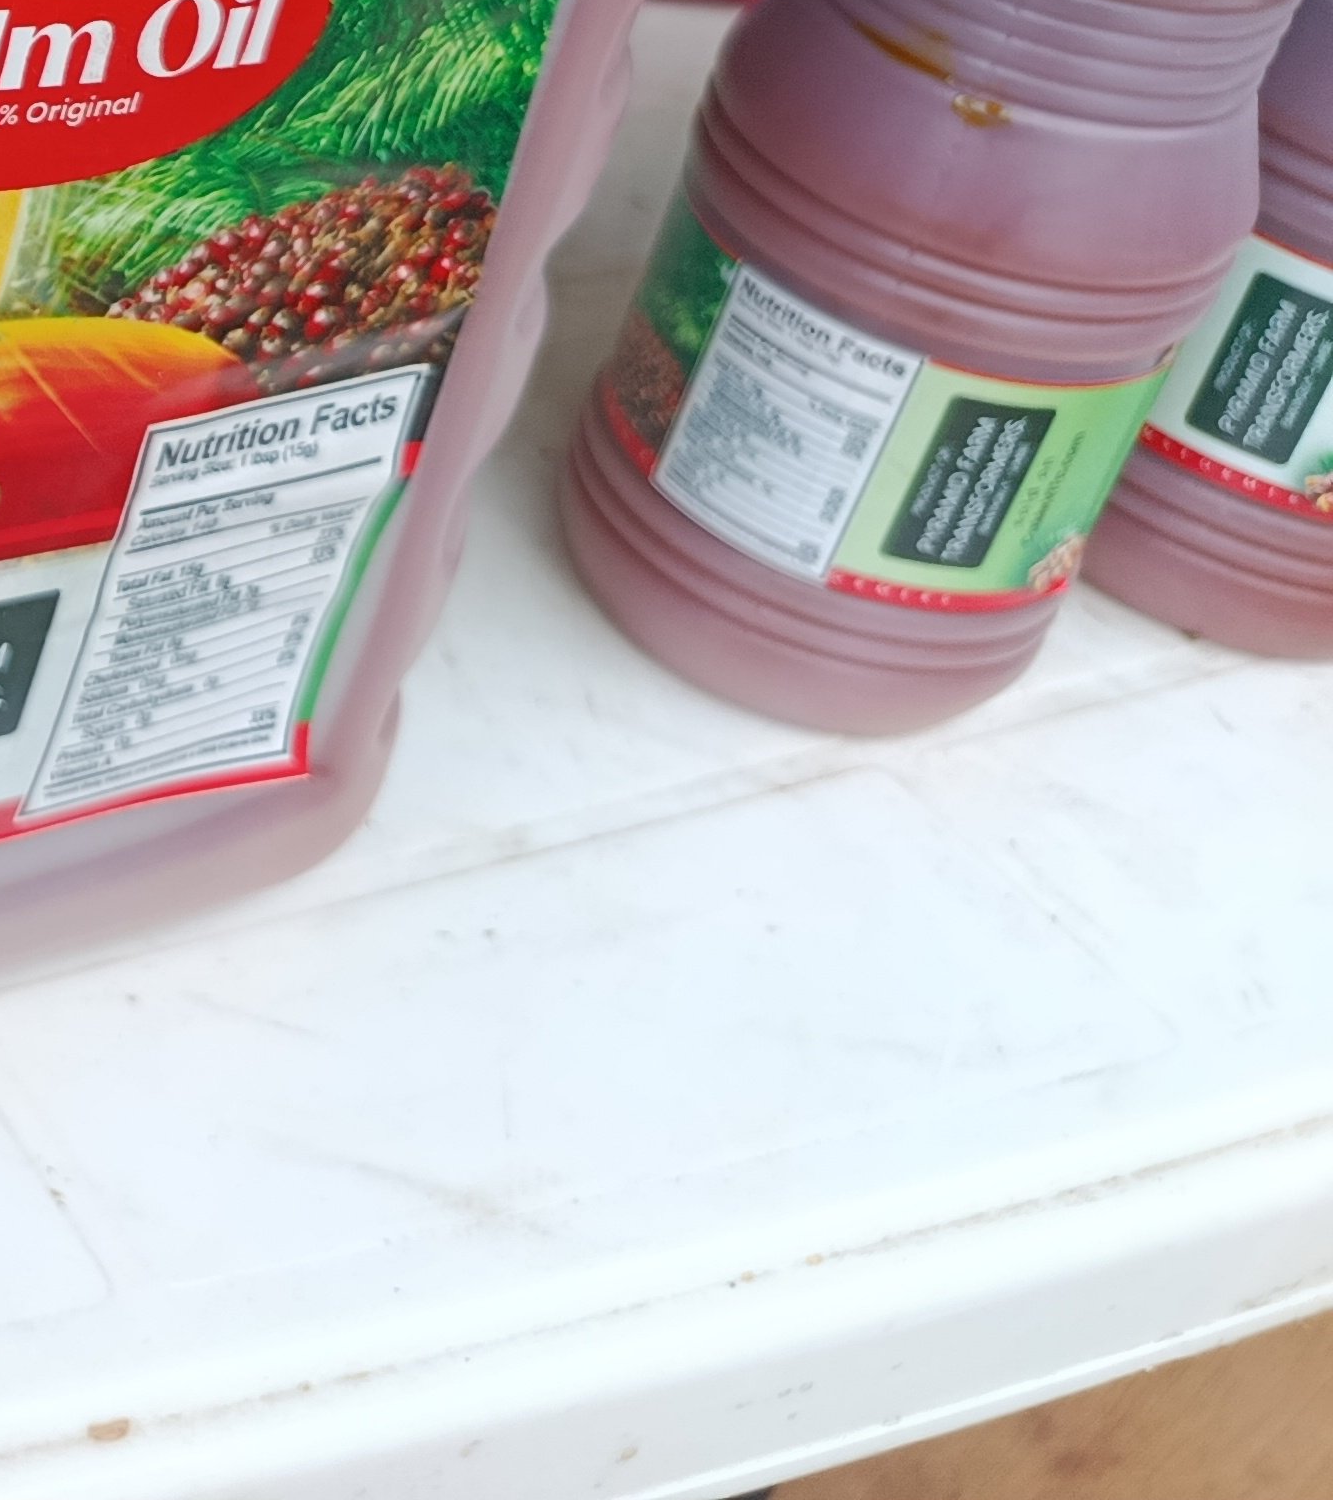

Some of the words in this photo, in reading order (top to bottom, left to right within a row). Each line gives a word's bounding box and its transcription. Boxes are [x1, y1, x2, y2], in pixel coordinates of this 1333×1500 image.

[26, 91, 142, 129] Original
[740, 275, 831, 345] Nutrition
[837, 335, 907, 380] Facts
[155, 415, 301, 473] Nutrition
[309, 392, 399, 437] Facts
